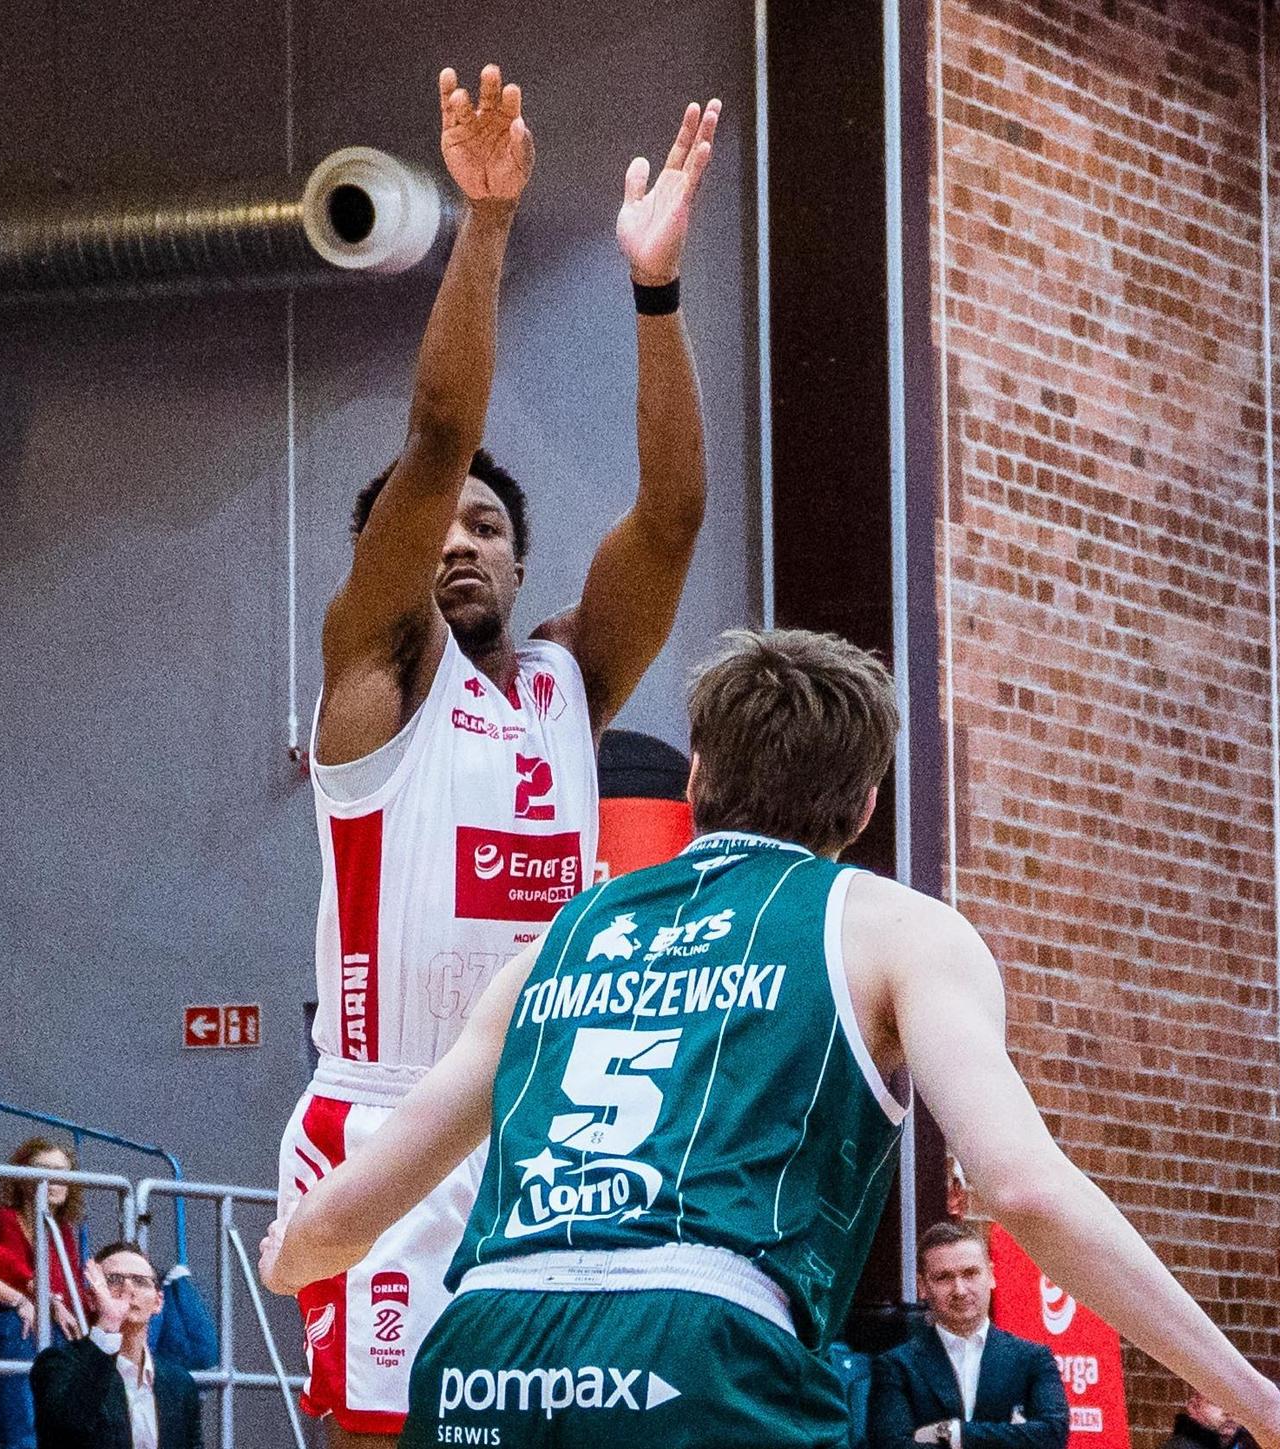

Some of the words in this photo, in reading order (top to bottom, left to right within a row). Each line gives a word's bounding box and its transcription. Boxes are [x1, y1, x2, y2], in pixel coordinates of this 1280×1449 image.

[514, 752, 556, 821] 2
[510, 853, 578, 883] Energ
[509, 889, 546, 902] GRUPA
[514, 933, 539, 944] MOW
[343, 952, 369, 1061] ZARNI
[516, 965, 786, 1029] TOMASZEWSKI
[547, 1027, 683, 1156] 5
[529, 1173, 629, 1223] LOTTO
[373, 1284, 408, 1293] ORLEN
[370, 1347, 405, 1356] Basket
[377, 1356, 399, 1367] Liga
[439, 1366, 642, 1420] pompax
[1073, 1411, 1100, 1427] RLEN
[437, 1425, 501, 1446] SERWIS
